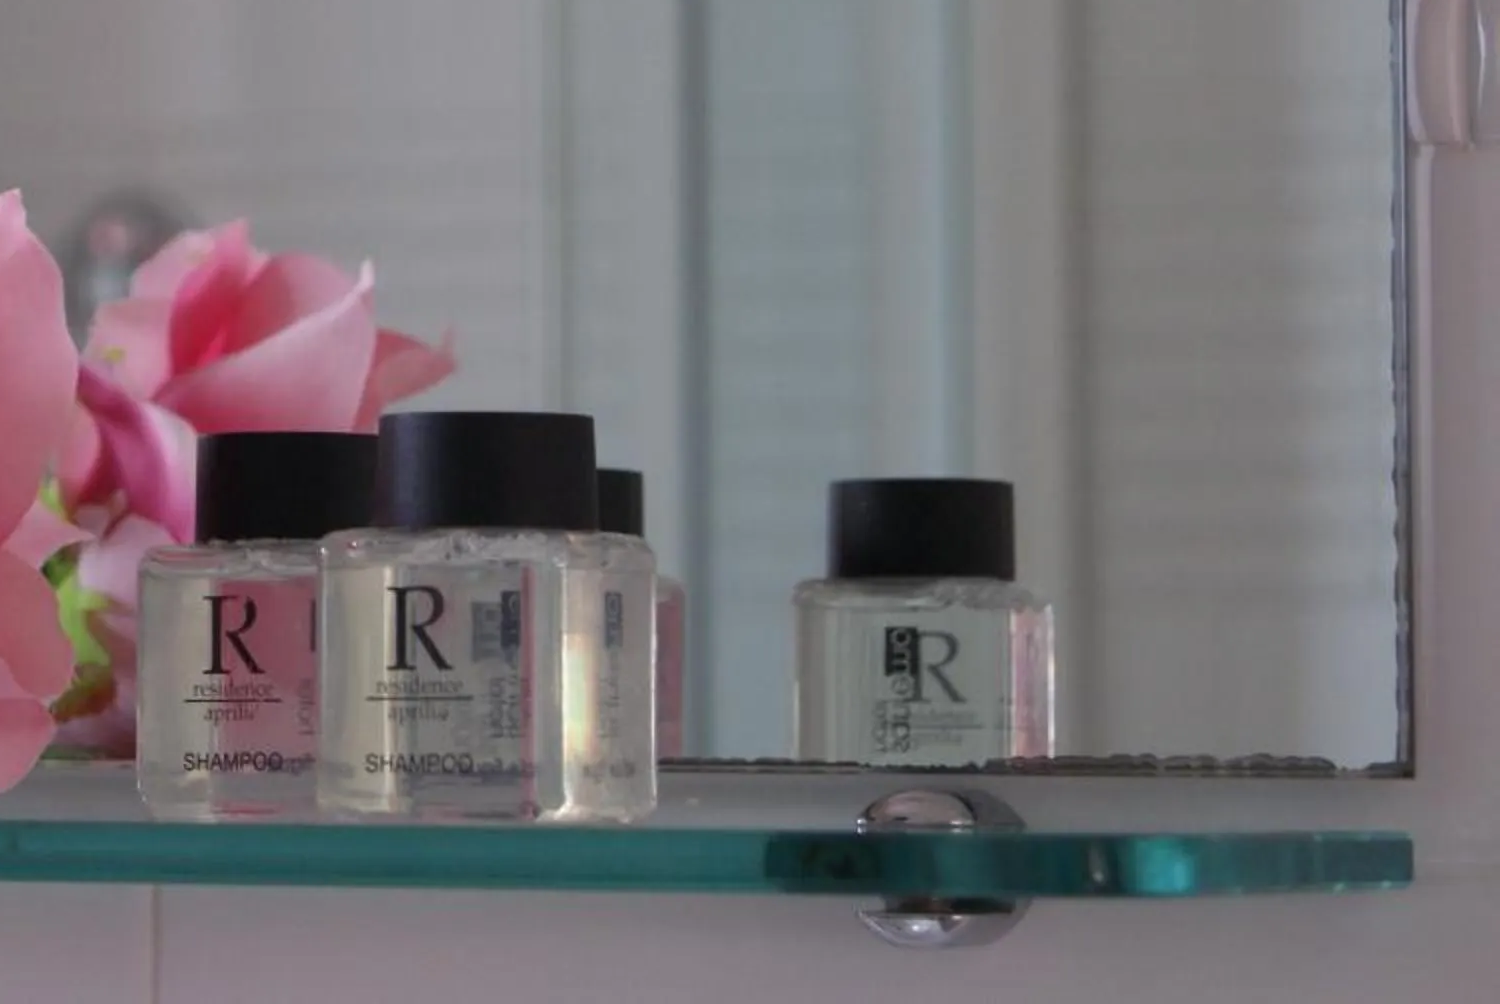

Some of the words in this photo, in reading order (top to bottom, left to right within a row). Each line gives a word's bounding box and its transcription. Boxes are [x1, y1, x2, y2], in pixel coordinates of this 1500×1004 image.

[202, 595, 266, 675] R
[386, 585, 454, 671] R
[192, 678, 275, 696] residence
[376, 675, 464, 694] residence
[183, 752, 284, 773] SHAMPOO
[365, 752, 474, 775] SHAMPOO
